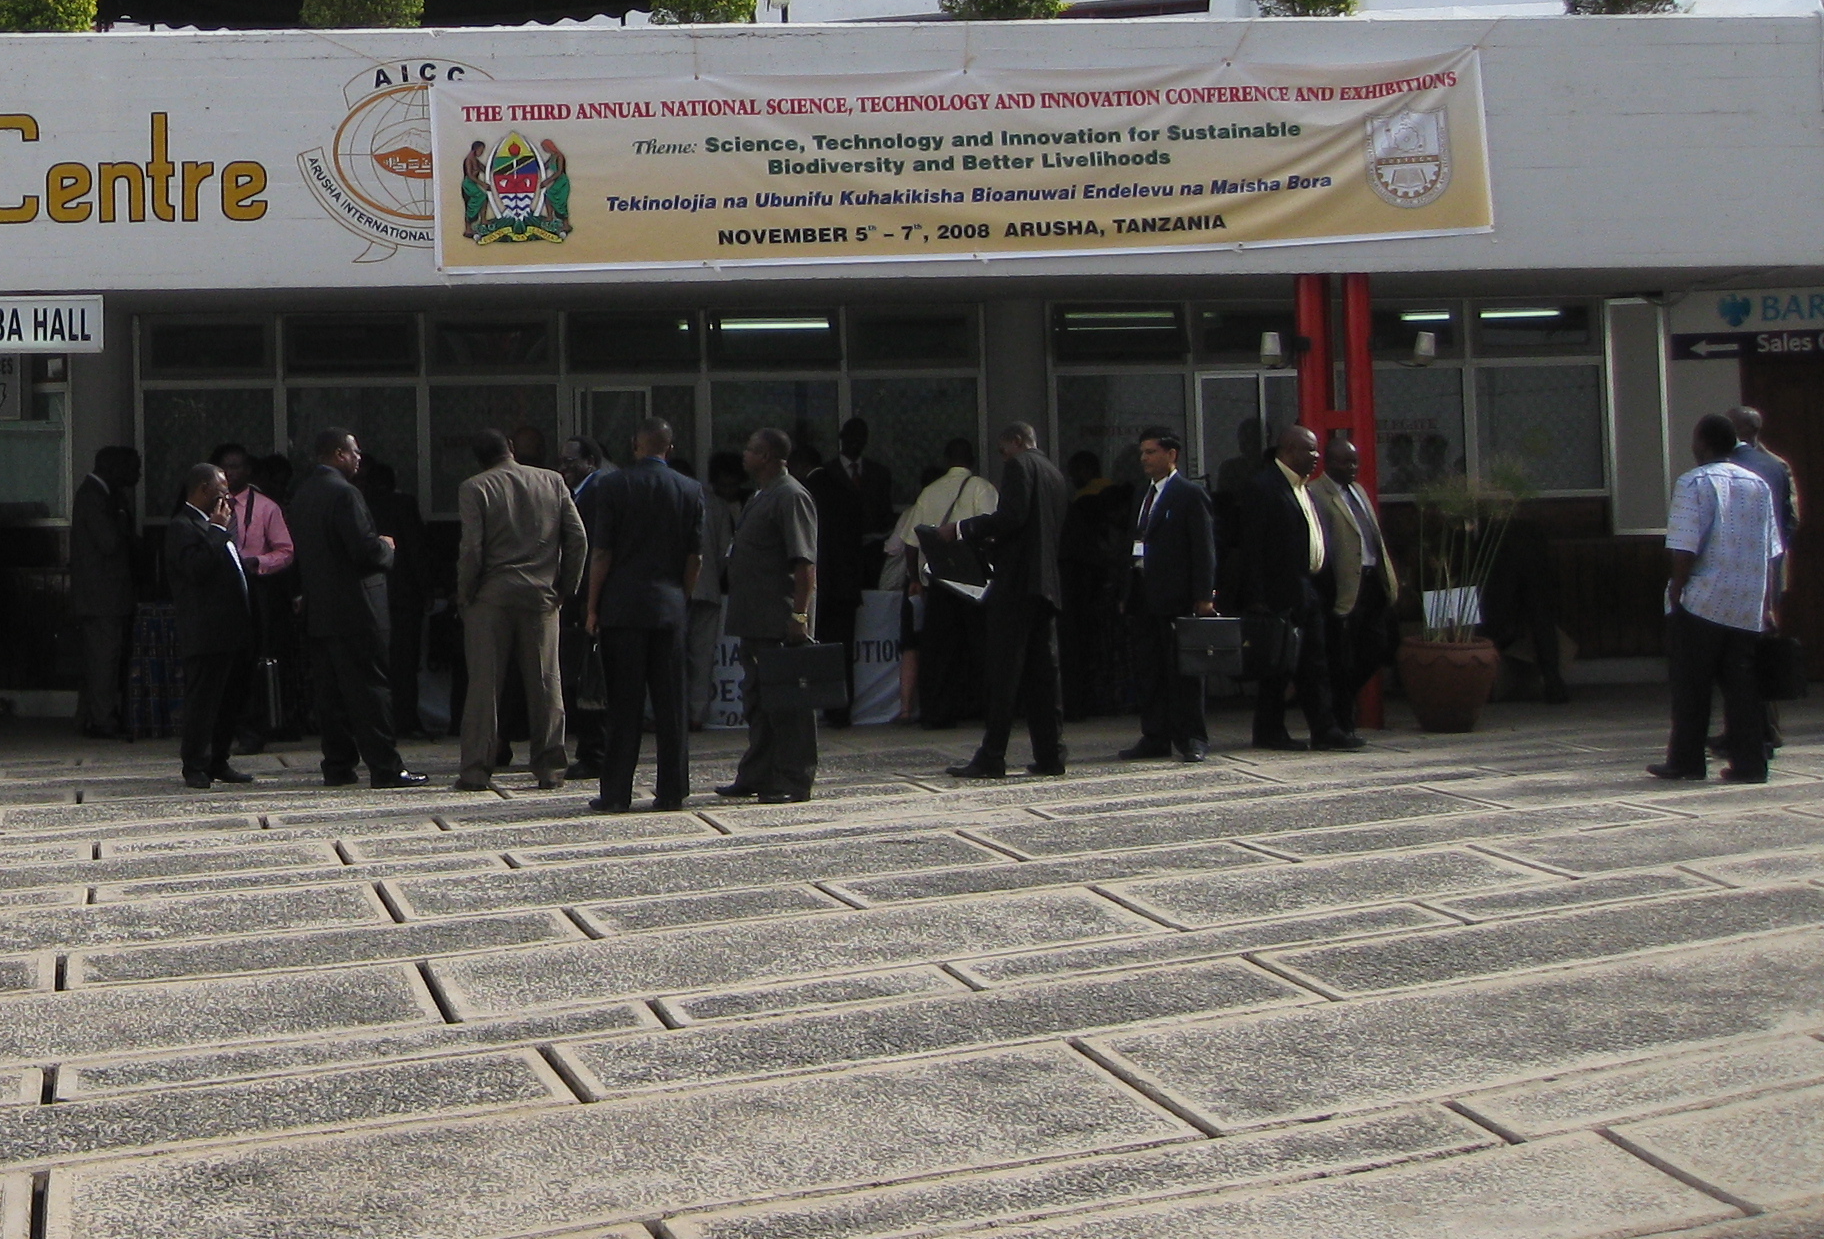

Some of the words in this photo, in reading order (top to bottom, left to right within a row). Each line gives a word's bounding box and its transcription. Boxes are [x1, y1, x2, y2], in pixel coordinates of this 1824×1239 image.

[461, 105, 503, 123] THE
[507, 103, 572, 122] THIRD
[576, 101, 657, 120] ANNUAL
[660, 98, 762, 118] NATIONAL
[766, 96, 853, 117] SCIENCE,
[856, 93, 991, 112] TECHNOLOGY
[994, 92, 1036, 110] AND
[1040, 88, 1160, 109] INNOVATION
[1164, 85, 1290, 105] CONFERENCE
[1294, 86, 1334, 103] AND
[1339, 70, 1458, 101] EXHIBITIONS
[631, 138, 698, 156] Theme:
[704, 135, 806, 153] Science,
[812, 132, 944, 151] Technology
[951, 131, 994, 147] and
[1001, 128, 1122, 147] Innovation
[1127, 124, 1160, 141] for
[1166, 121, 1302, 141] Sustainable
[768, 155, 906, 176] Biodiversity
[912, 155, 955, 172] and
[962, 152, 1034, 171] Better
[1041, 149, 1172, 169] Livelihoods
[307, 157, 342, 203] ARUSHA
[340, 198, 434, 241] INTERNATIONAL
[606, 193, 717, 213] Tekinolojia
[722, 196, 749, 210] na
[755, 190, 833, 208] Ubunifu
[839, 187, 965, 205] Kuhakikisha
[971, 184, 1077, 203] Bioanuwai
[1082, 179, 1174, 200] Endelevu
[1179, 182, 1204, 197] na
[1209, 177, 1281, 195] Maisha
[1286, 174, 1333, 190] Bora
[717, 226, 849, 246] NOVEMBER
[937, 222, 990, 240] 2008
[1004, 218, 1106, 239] ARUSHA,
[1112, 213, 1228, 234] TANZANIA
[33, 307, 92, 342] HALL
[1756, 333, 1813, 352] Sales
